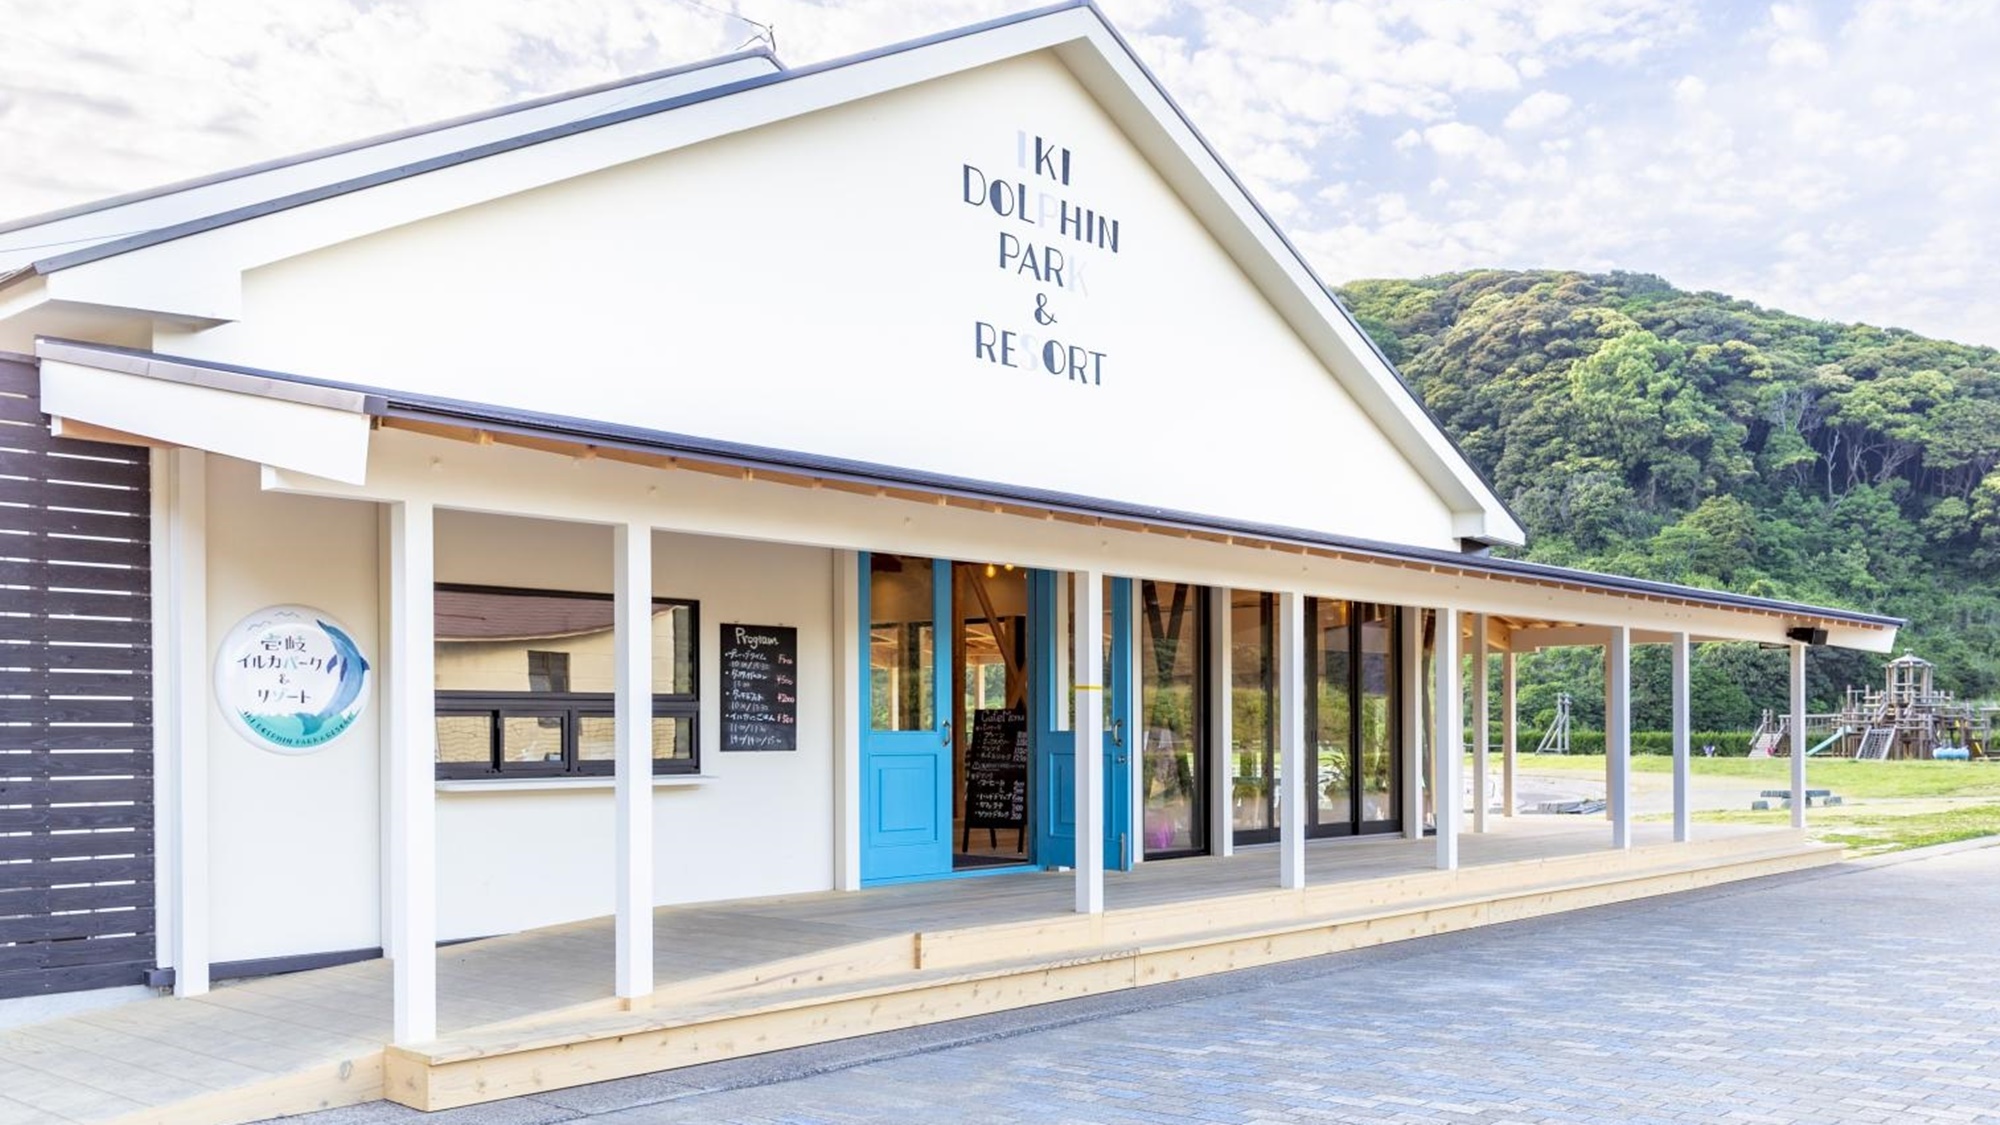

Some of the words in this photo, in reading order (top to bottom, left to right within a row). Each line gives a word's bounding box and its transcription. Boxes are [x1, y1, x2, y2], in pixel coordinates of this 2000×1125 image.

[1017, 130, 1071, 187] IKI
[963, 164, 1119, 254] DOLPHIN
[999, 232, 1090, 299] PARK
[1034, 293, 1058, 326] &
[975, 321, 1108, 386] RESORT
[261, 633, 307, 653] 壱岐
[735, 627, 779, 649] Program
[237, 654, 323, 671] イルカパーク
[258, 689, 312, 704] リゾート
